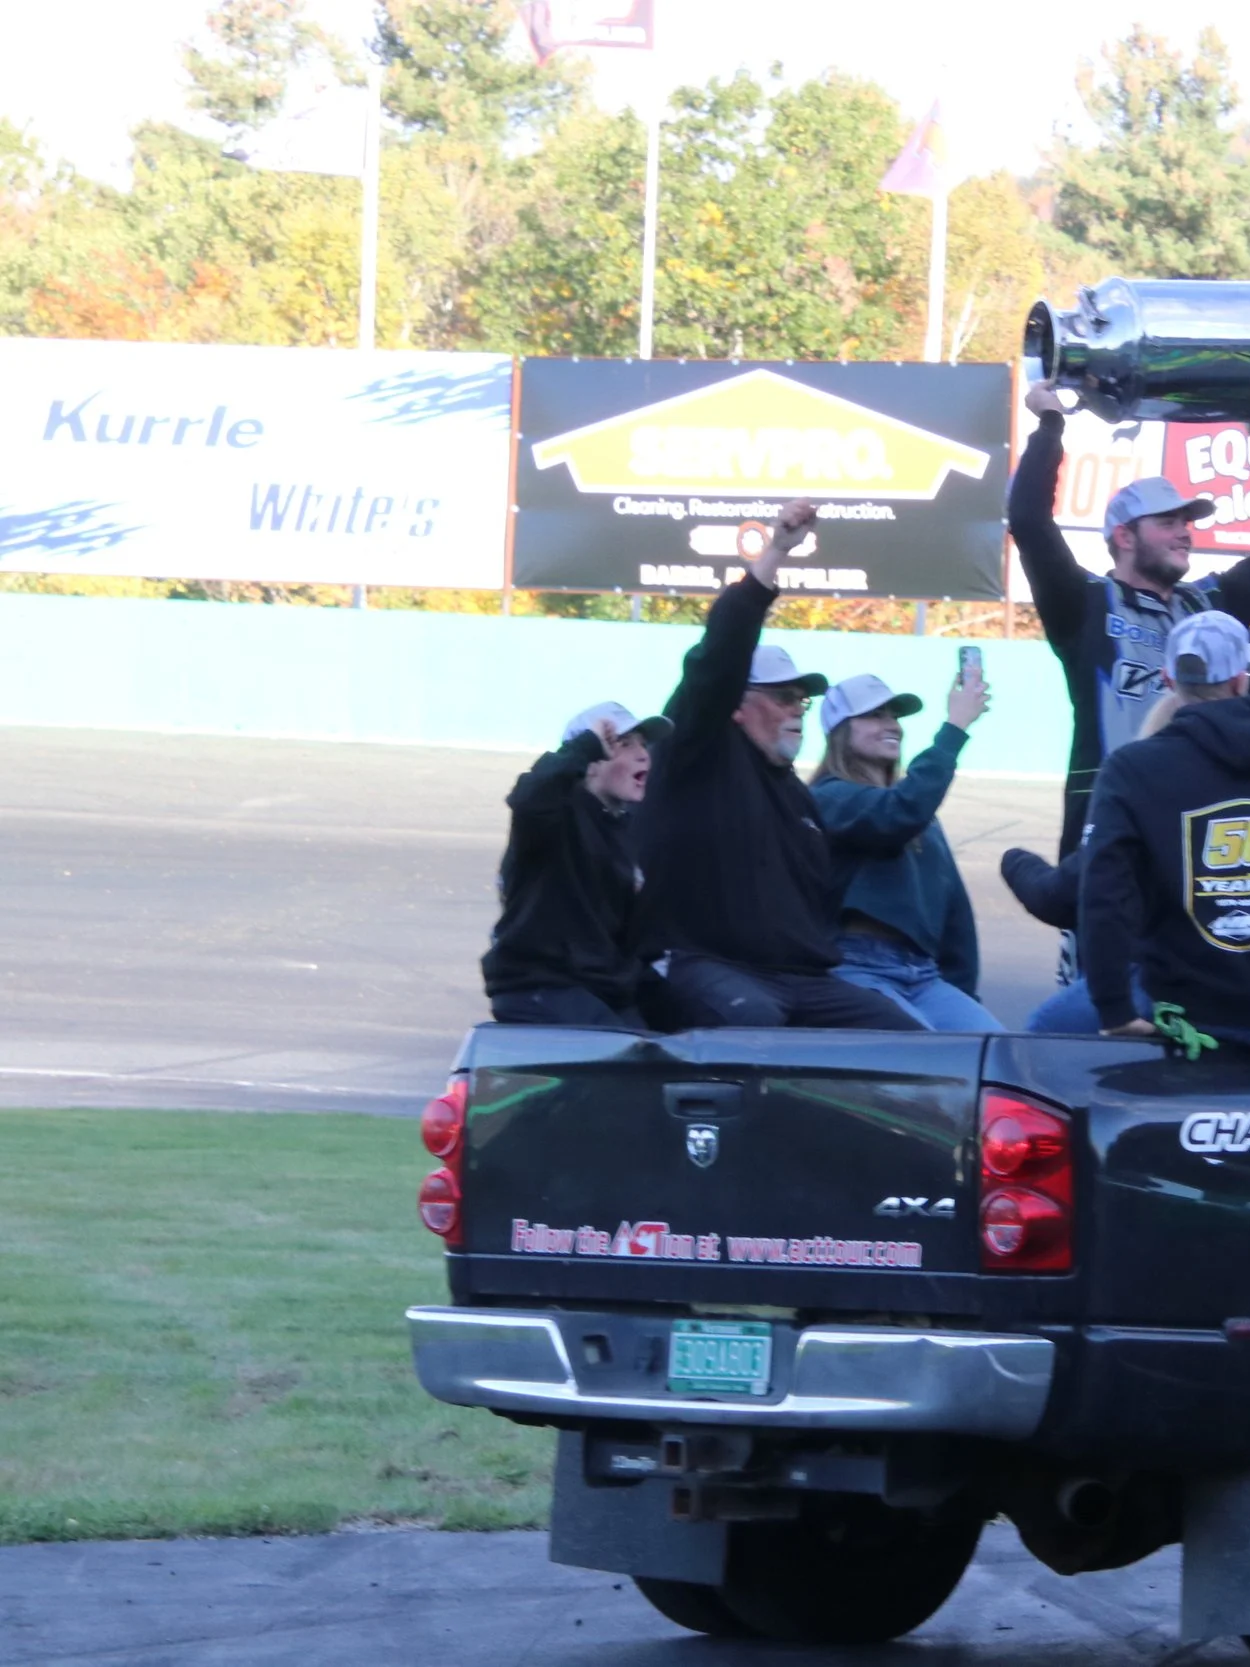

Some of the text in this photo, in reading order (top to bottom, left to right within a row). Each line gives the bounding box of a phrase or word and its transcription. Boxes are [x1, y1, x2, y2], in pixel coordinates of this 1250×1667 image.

[42, 389, 264, 448] Kurrle
[249, 482, 440, 537] White's
[511, 1218, 575, 1253] Follow
